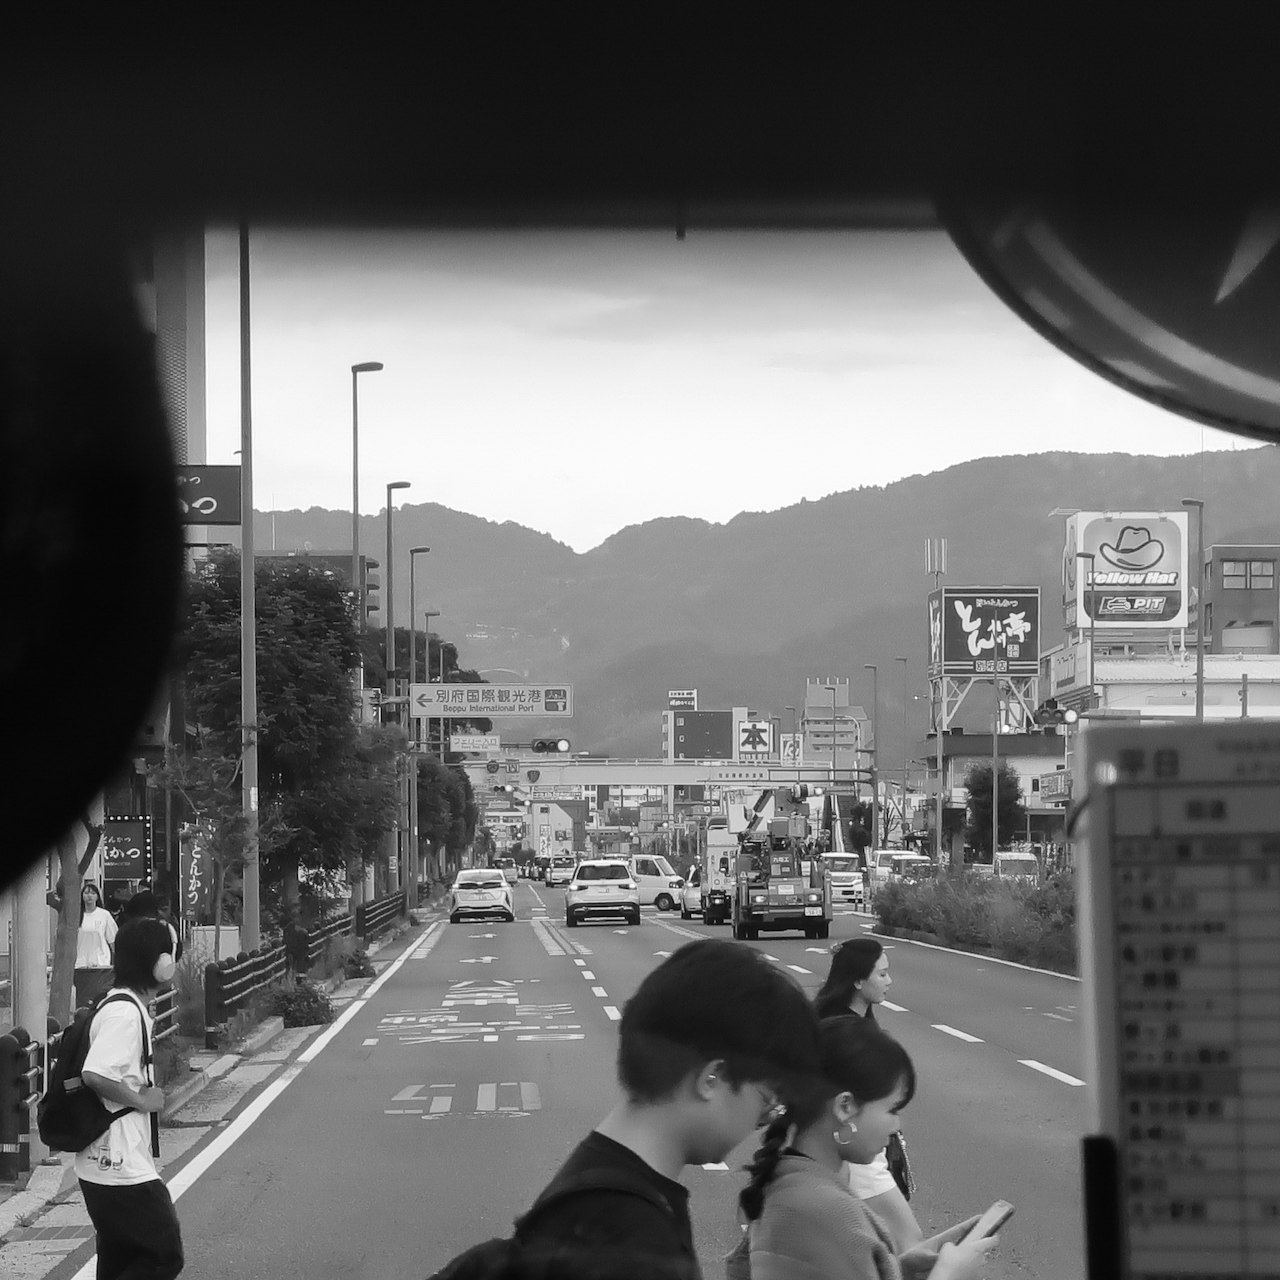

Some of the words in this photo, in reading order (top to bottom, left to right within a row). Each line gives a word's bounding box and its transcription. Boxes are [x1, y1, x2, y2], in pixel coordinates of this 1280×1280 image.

[1087, 571, 1144, 586] Yellow
[1145, 571, 1178, 586] Hat
[1133, 598, 1164, 609] PIT
[436, 689, 542, 703] 別府国際観光港
[443, 704, 467, 713] Beppu
[469, 704, 515, 712] International
[518, 704, 534, 712] Port
[741, 723, 768, 750] 本
[187, 845, 203, 905] とんかつ
[383, 1081, 543, 1115] 50
